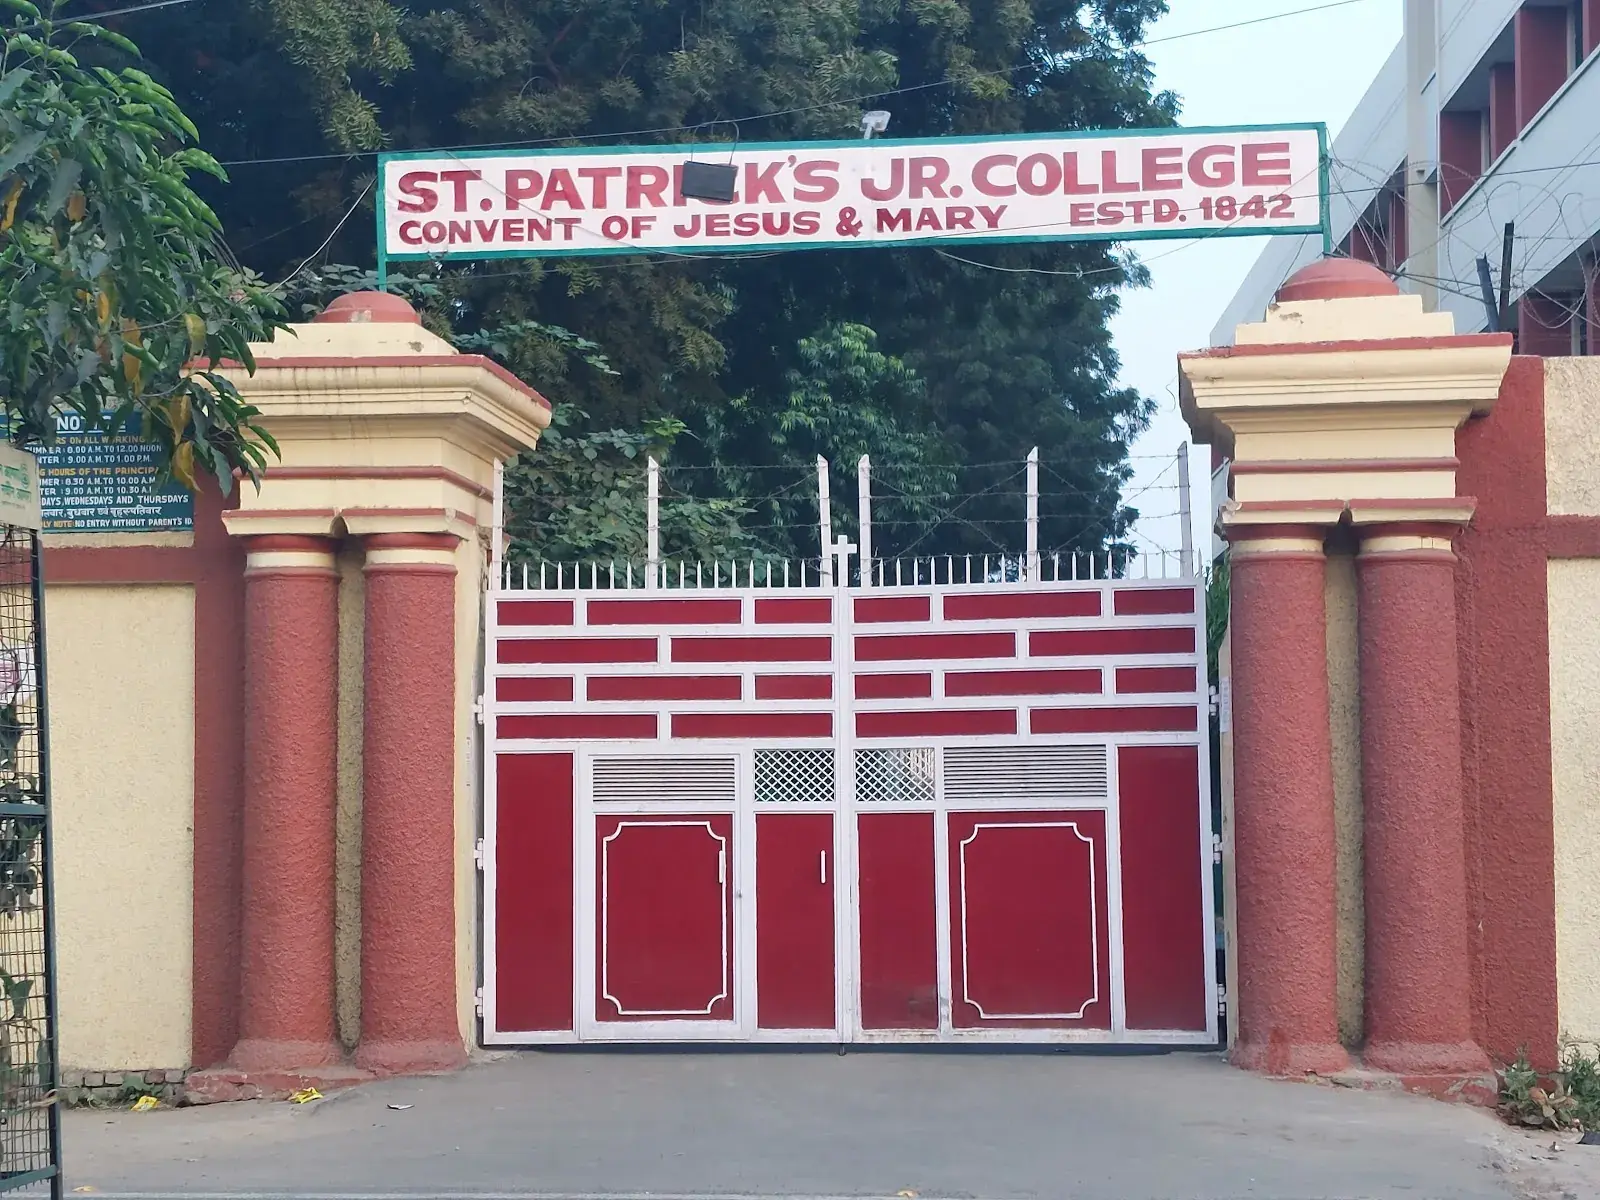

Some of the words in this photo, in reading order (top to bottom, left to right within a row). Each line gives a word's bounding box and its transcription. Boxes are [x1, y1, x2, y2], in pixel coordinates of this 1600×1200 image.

[397, 169, 493, 213] ST.
[505, 155, 840, 209] PATRIK'S
[860, 156, 963, 202] JR.
[972, 142, 1292, 197] COLLEGE
[399, 217, 578, 248] CONVENT
[601, 216, 657, 241] OF
[674, 210, 820, 240] JESUS
[836, 204, 863, 237] &
[876, 204, 1008, 233] MARY
[1069, 198, 1188, 228] ESTD.
[1199, 194, 1295, 221] 1842
[84, 436, 99, 444] ALL
[102, 435, 146, 444] WRKING
[104, 445, 115, 453] TO
[116, 445, 138, 453] 12.00
[140, 444, 162, 452] NOON
[67, 456, 87, 464] 9.00
[104, 455, 115, 463] TO
[116, 455, 135, 463] 1.00
[49, 468, 76, 476] HOURS
[79, 468, 91, 476] OF
[93, 467, 111, 475] THE
[103, 477, 114, 485] TO
[116, 476, 139, 484] 10.00
[65, 487, 84, 495] 9.00
[116, 486, 139, 494] 10.30
[116, 496, 133, 504] AND
[137, 494, 189, 504] THURSDAYS
[74, 520, 85, 528] NO
[86, 519, 110, 527] ENTRY
[112, 518, 146, 527] WITHOUT
[148, 517, 182, 526] PARENT'S
